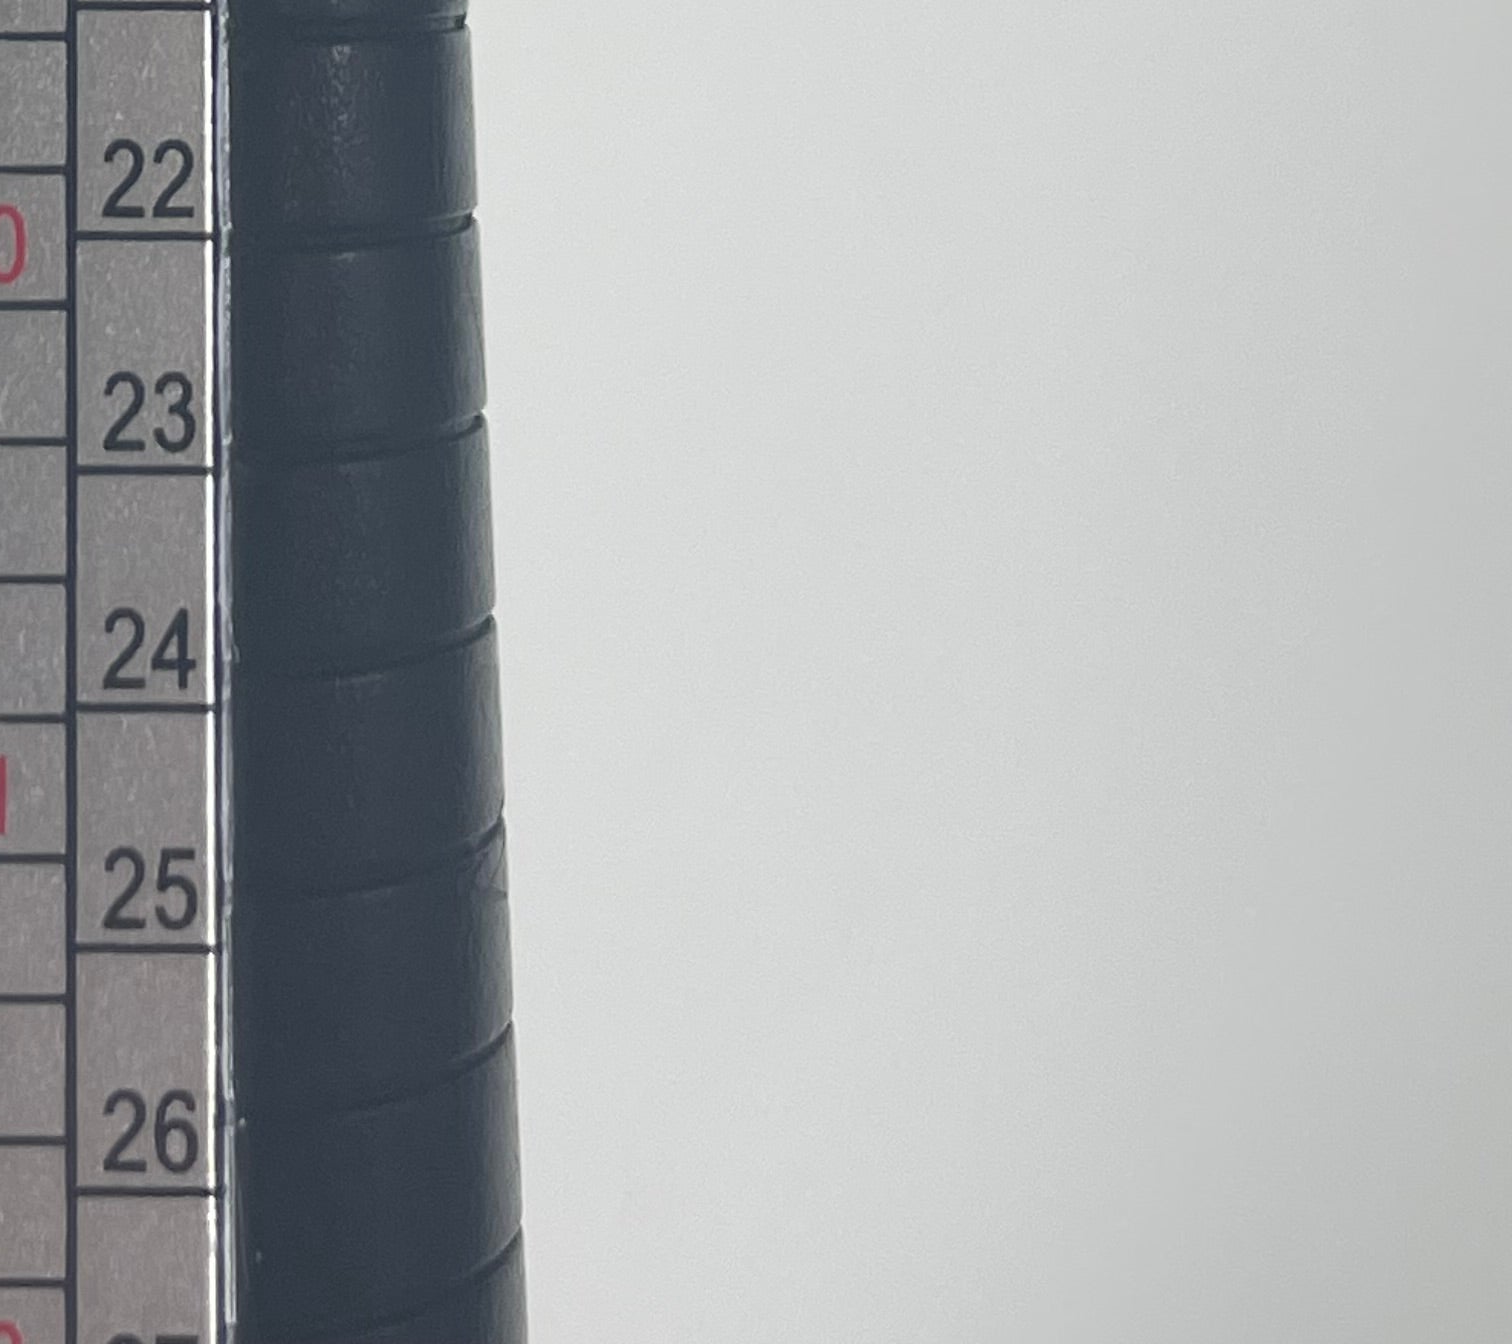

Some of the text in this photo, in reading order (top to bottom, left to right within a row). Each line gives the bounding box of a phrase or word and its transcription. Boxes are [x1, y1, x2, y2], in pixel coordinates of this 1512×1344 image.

[100, 138, 196, 220] 22
[101, 370, 198, 455] 23
[101, 606, 198, 692] 24
[101, 845, 199, 932] 25
[102, 1088, 200, 1176] 26
